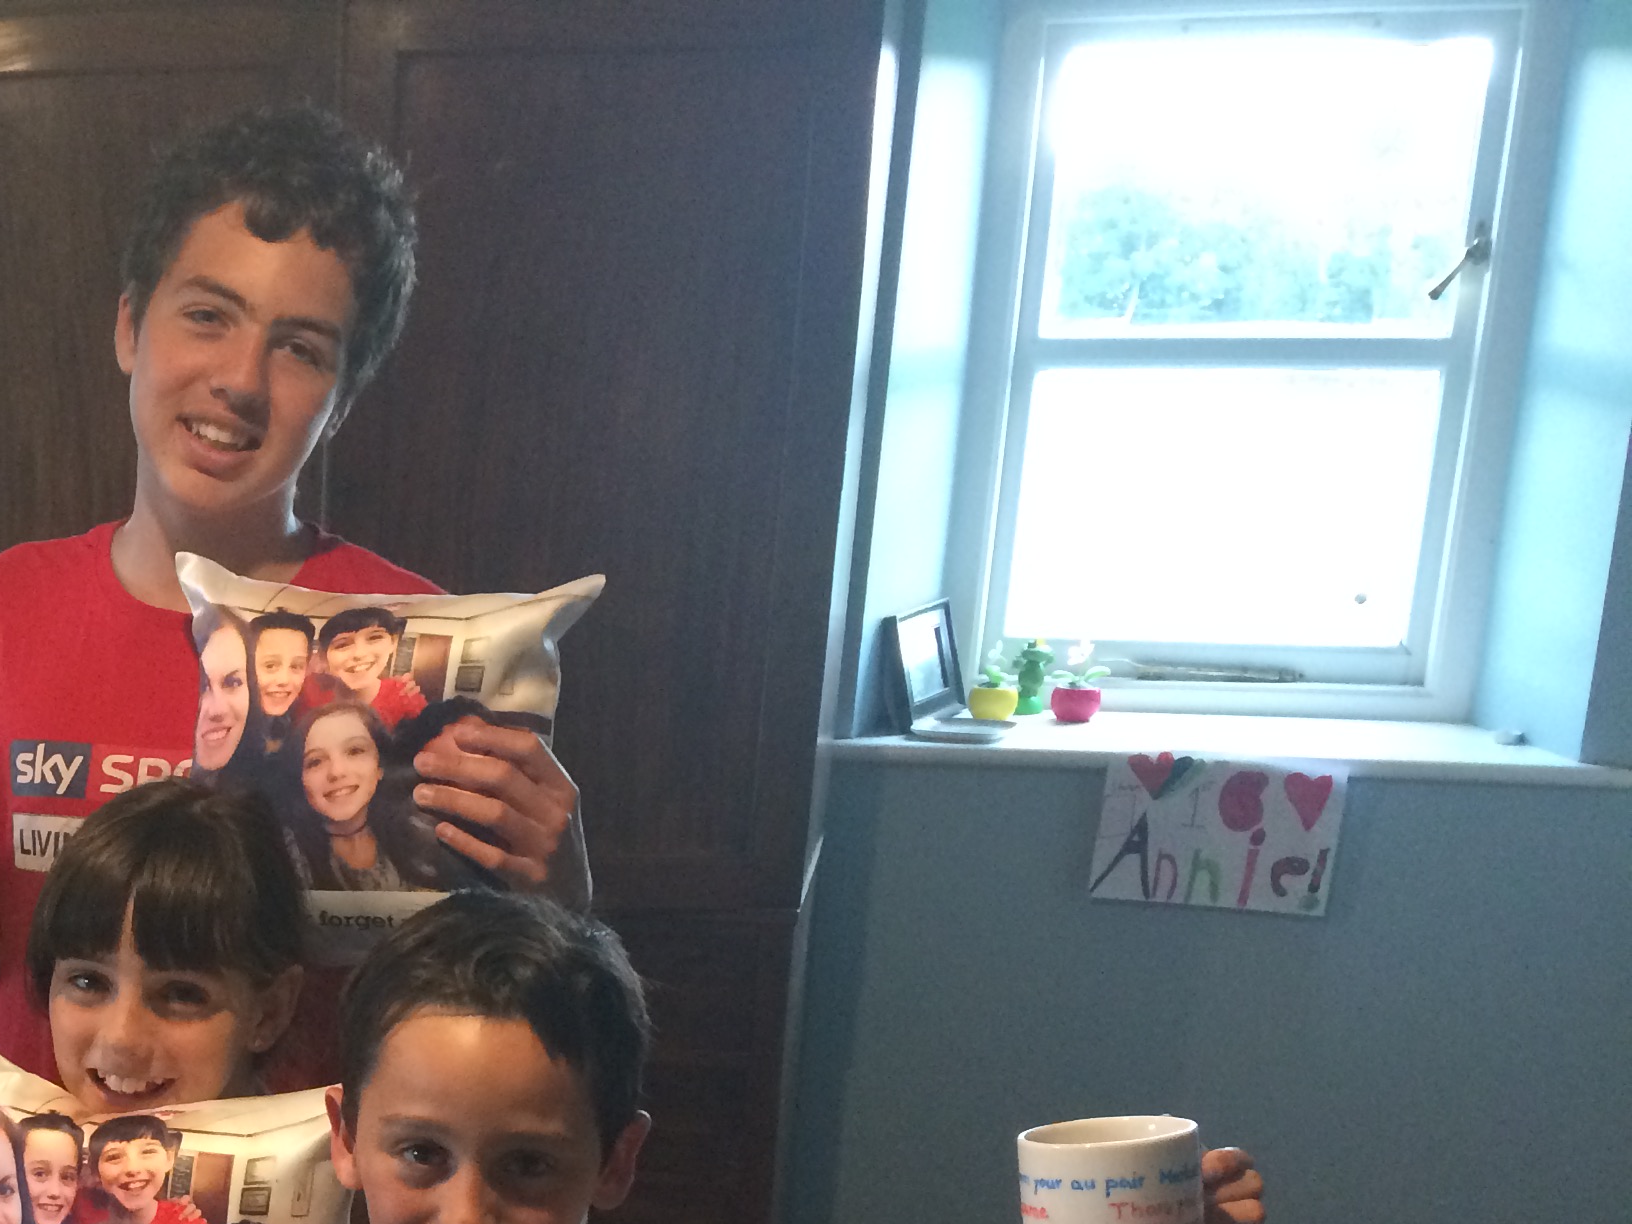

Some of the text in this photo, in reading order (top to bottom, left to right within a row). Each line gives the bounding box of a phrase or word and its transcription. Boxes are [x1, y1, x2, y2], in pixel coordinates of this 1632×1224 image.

[15, 743, 83, 795] sky
[1089, 810, 1331, 909] Annie!
[319, 910, 394, 930] forget
[1033, 1179, 1062, 1195] your
[1070, 1178, 1096, 1191] au
[1105, 1172, 1145, 1198] pair
